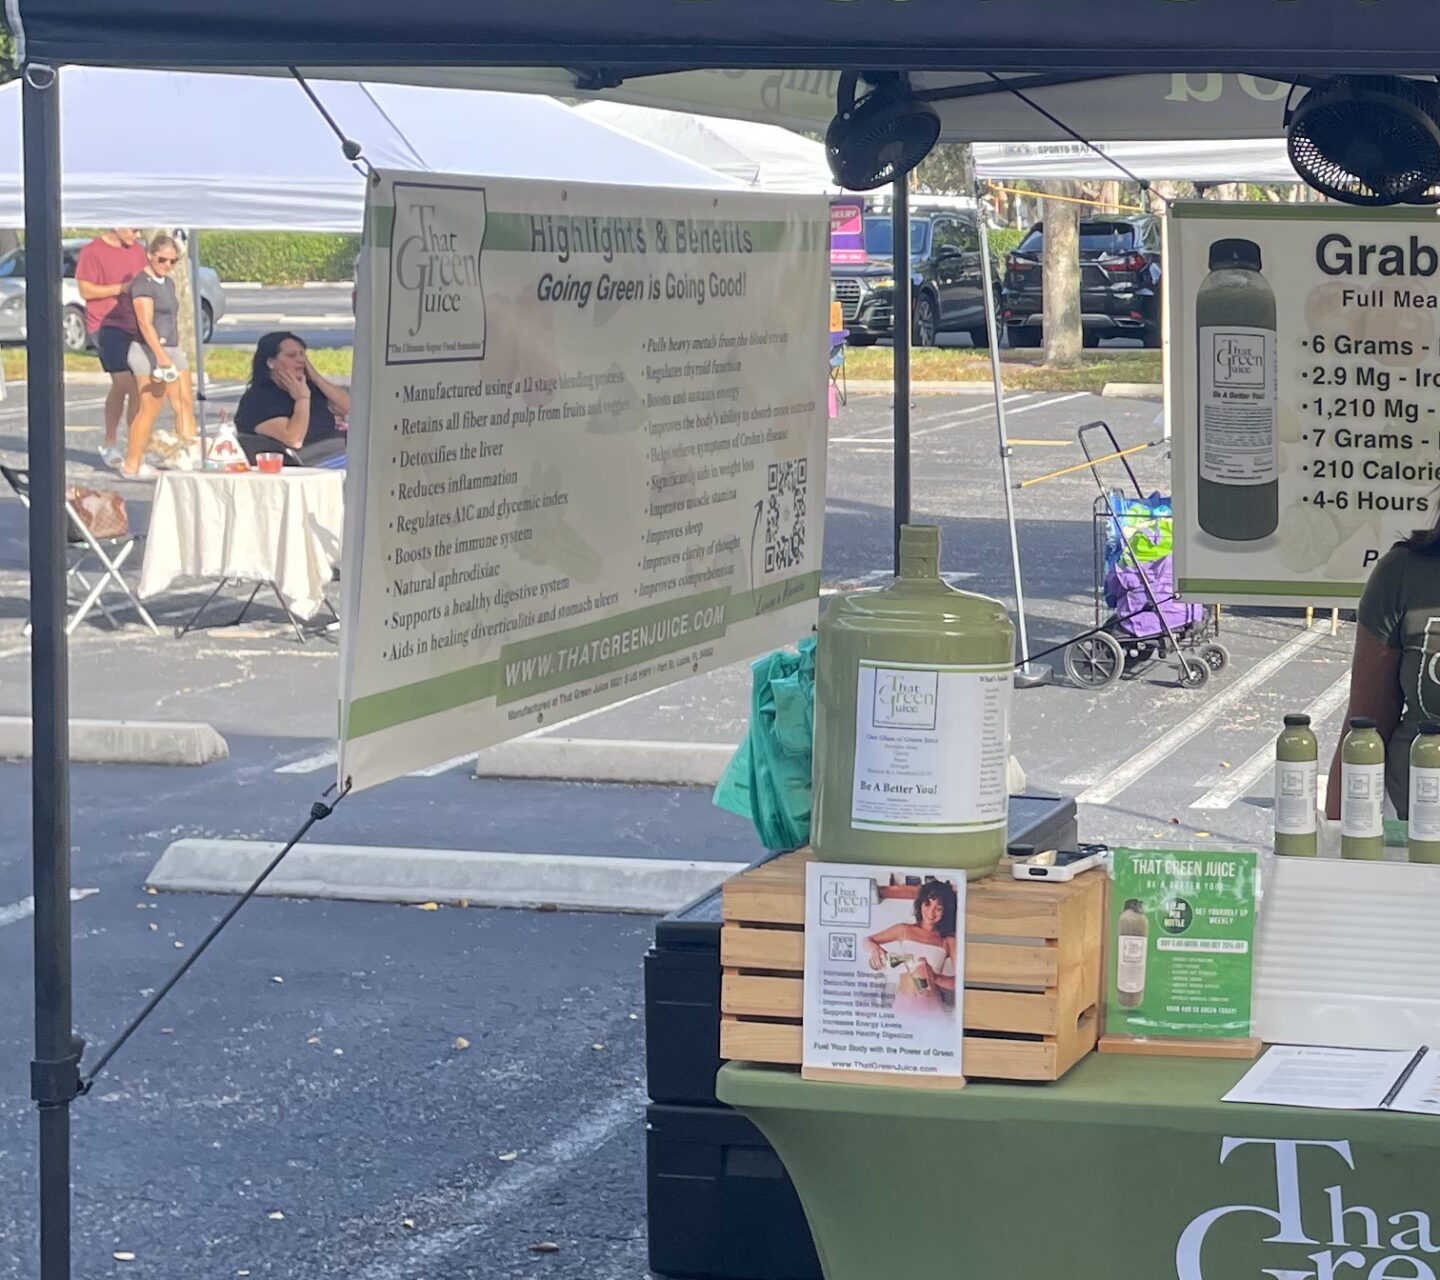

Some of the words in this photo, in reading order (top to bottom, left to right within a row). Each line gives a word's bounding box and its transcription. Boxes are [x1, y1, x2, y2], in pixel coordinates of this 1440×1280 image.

[409, 204, 457, 253] That
[530, 215, 647, 263] Highlights
[655, 219, 668, 253] &
[675, 220, 753, 254] Benefits
[396, 235, 479, 291] Green
[1314, 233, 1439, 276] Grab
[408, 263, 461, 337] Juice
[537, 272, 592, 308] Going
[596, 273, 644, 302] Green
[648, 273, 661, 301] is
[665, 272, 705, 306] Going
[709, 271, 747, 297] Good!
[1342, 289, 1384, 308] Full
[668, 335, 691, 354] heavy
[692, 334, 717, 350] metals
[1221, 339, 1252, 356] That
[1312, 335, 1326, 354] 6
[1334, 335, 1413, 356] Grams
[1216, 348, 1263, 367] Green
[1224, 357, 1251, 380] Juice
[402, 379, 482, 403] Manufactured
[485, 378, 513, 399] using
[514, 383, 521, 394] a
[523, 378, 533, 393] 12
[534, 377, 558, 395] stage
[1312, 367, 1347, 386] 2.9
[1356, 367, 1391, 391] Mg
[401, 416, 443, 436] Retains
[446, 411, 460, 430] all
[462, 410, 487, 430] fiber
[490, 407, 510, 426] and
[511, 405, 536, 429] pulp
[537, 403, 561, 422] from
[562, 400, 586, 419] fruits
[1313, 398, 1375, 421] 1,210
[1384, 399, 1419, 422] Mg
[1312, 429, 1326, 447] 7
[1334, 429, 1413, 449] Grams
[400, 445, 457, 468] Detoxifies
[459, 441, 477, 461] the
[479, 440, 504, 458] liver
[1313, 460, 1354, 479] 210
[398, 479, 446, 501] Reduces
[448, 470, 518, 493] inflammation
[396, 510, 451, 535] Regulates
[476, 500, 495, 519] and
[496, 493, 540, 520] glycemic
[542, 490, 569, 508] index
[1313, 491, 1349, 510] 4-6
[1358, 491, 1429, 512] Hours
[395, 546, 432, 565] Boosts
[434, 540, 452, 558] the
[454, 533, 499, 554] immune
[500, 527, 533, 551] system
[392, 574, 436, 598] Natural
[438, 563, 500, 591] aphrodisiac
[391, 601, 442, 631] Supports
[443, 607, 450, 617] a
[452, 592, 492, 616] healthy
[493, 584, 538, 609] digestive
[539, 575, 570, 597] system
[388, 640, 415, 662] Aids
[416, 636, 428, 654] in
[430, 626, 469, 651] healing
[471, 612, 536, 641] diverticulitis
[536, 605, 556, 624] and
[557, 597, 593, 618] stomach
[594, 592, 619, 609] ulcers
[504, 604, 726, 687] WWW.THATGREENJUICE.COM
[878, 684, 934, 706] Green
[886, 674, 920, 694] That
[886, 691, 918, 719] Juice
[860, 780, 871, 791] Be
[873, 781, 881, 792] A
[883, 782, 913, 794] Better
[915, 784, 938, 795] You!
[1132, 859, 1161, 875] THAT
[1164, 859, 1202, 876] GREEN
[1204, 861, 1236, 877] JUICE
[899, 1047, 921, 1055] Power
